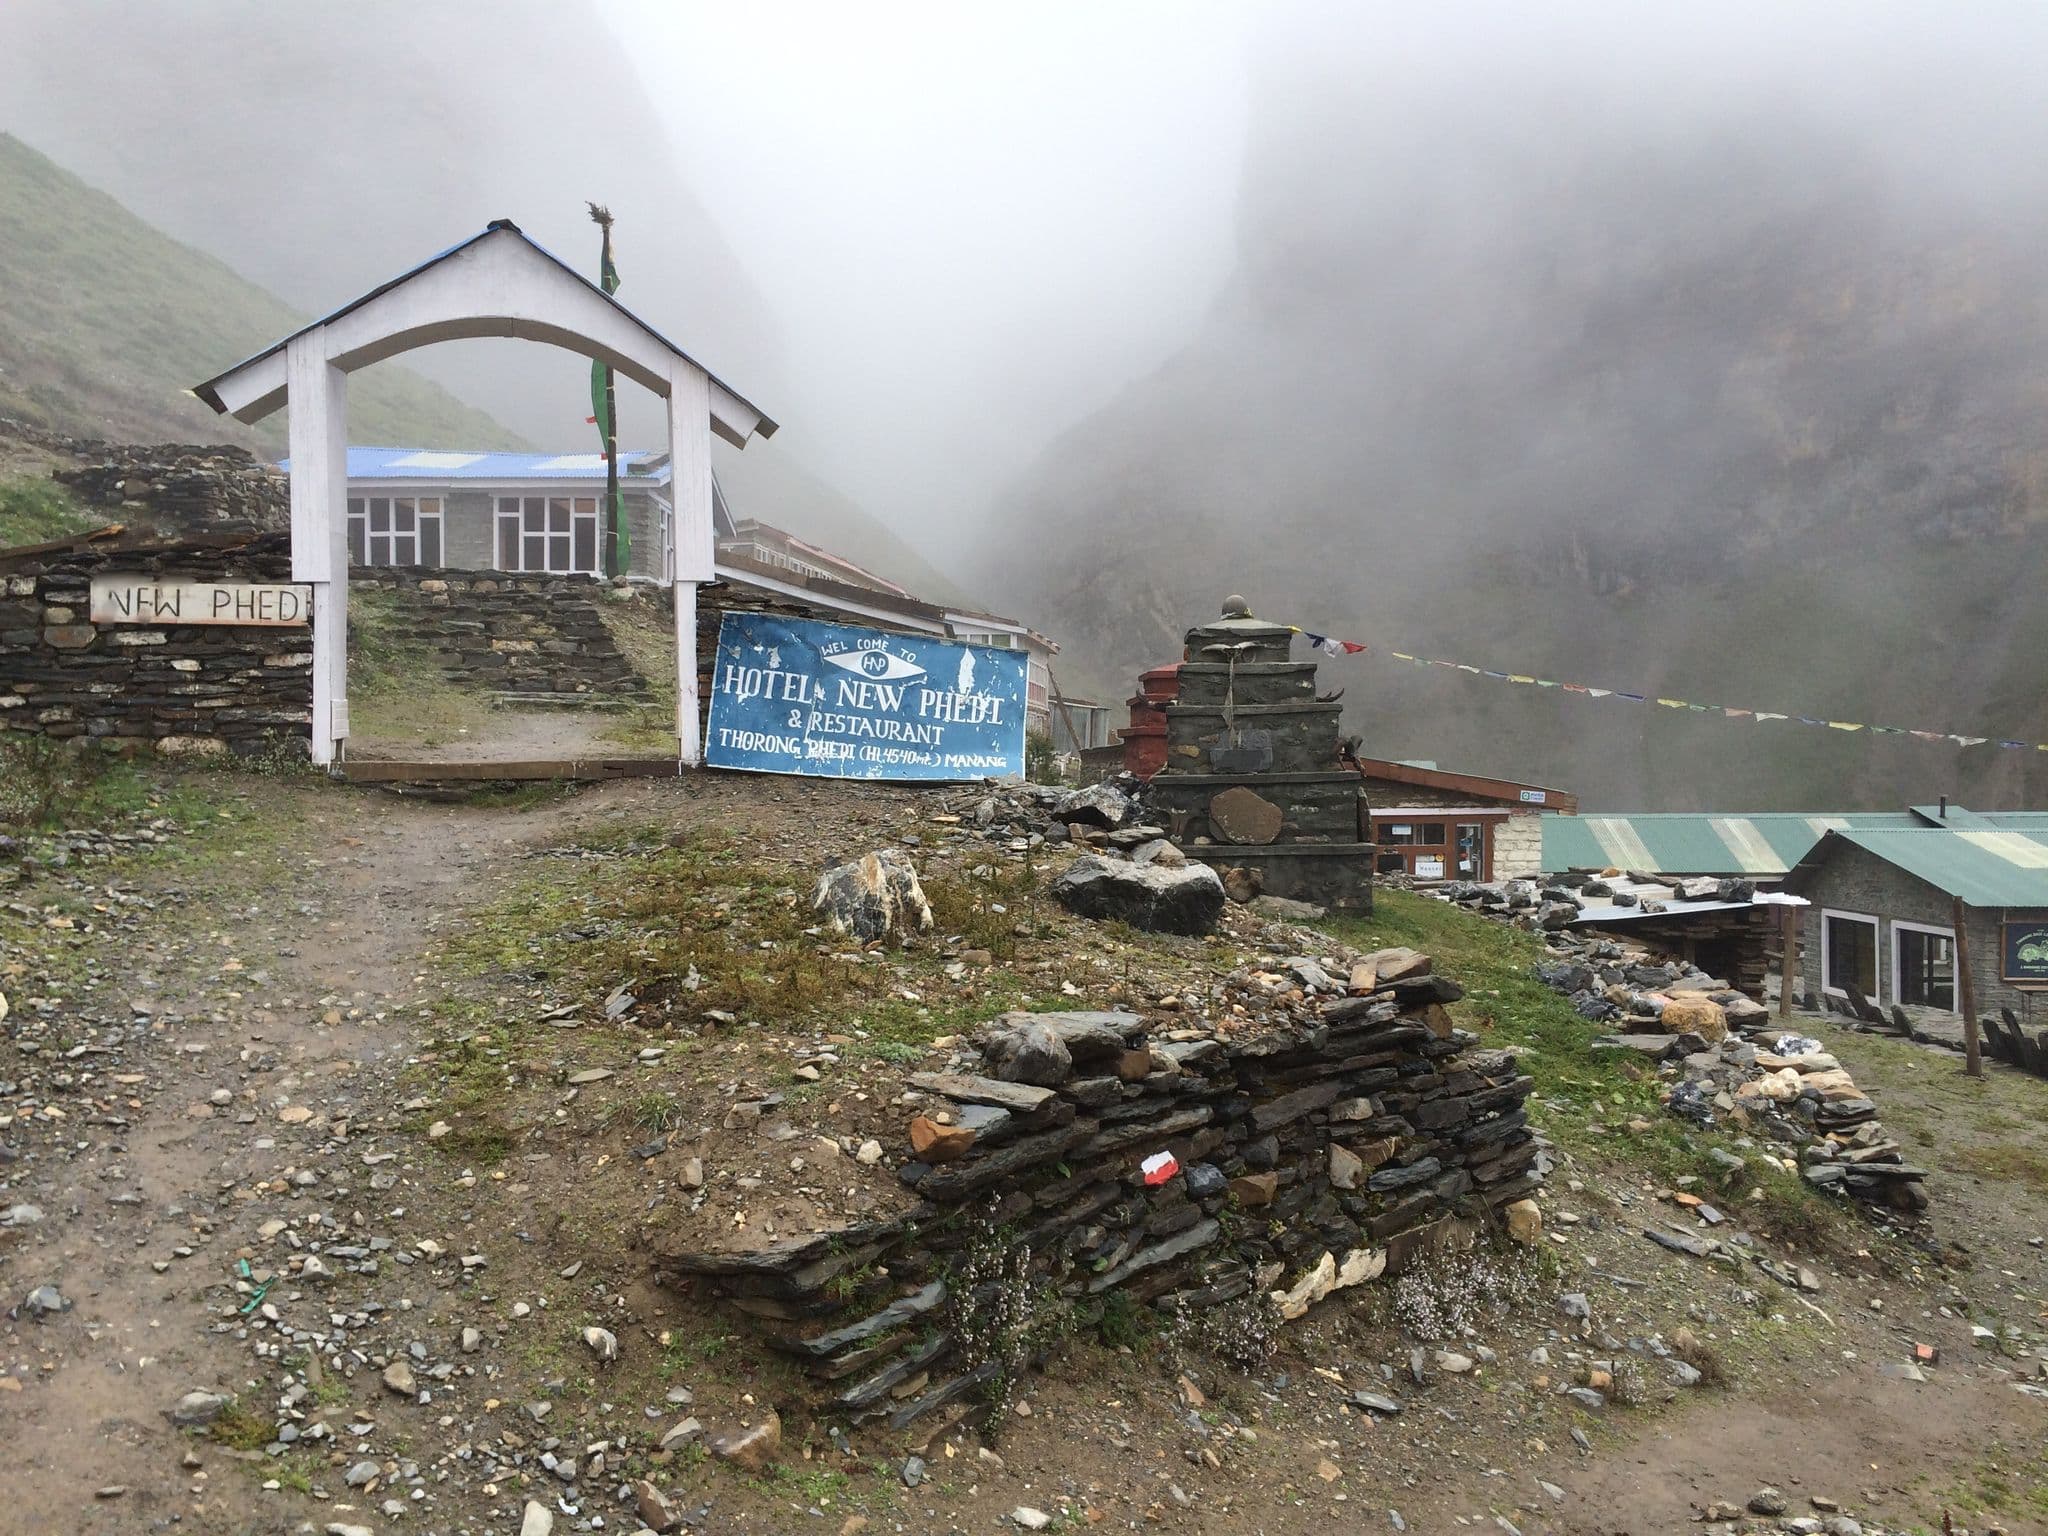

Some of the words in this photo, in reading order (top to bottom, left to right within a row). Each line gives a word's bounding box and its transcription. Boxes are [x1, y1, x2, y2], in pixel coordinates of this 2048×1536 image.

[821, 641, 849, 656] WEL
[857, 638, 889, 651] COME
[900, 648, 917, 663] TO
[723, 664, 812, 705] HOTEL
[836, 679, 905, 712] NEW
[788, 709, 802, 728] &
[811, 711, 945, 745] RESTAURANT
[719, 728, 802, 755] THORONG
[944, 753, 1007, 768] MANANG
